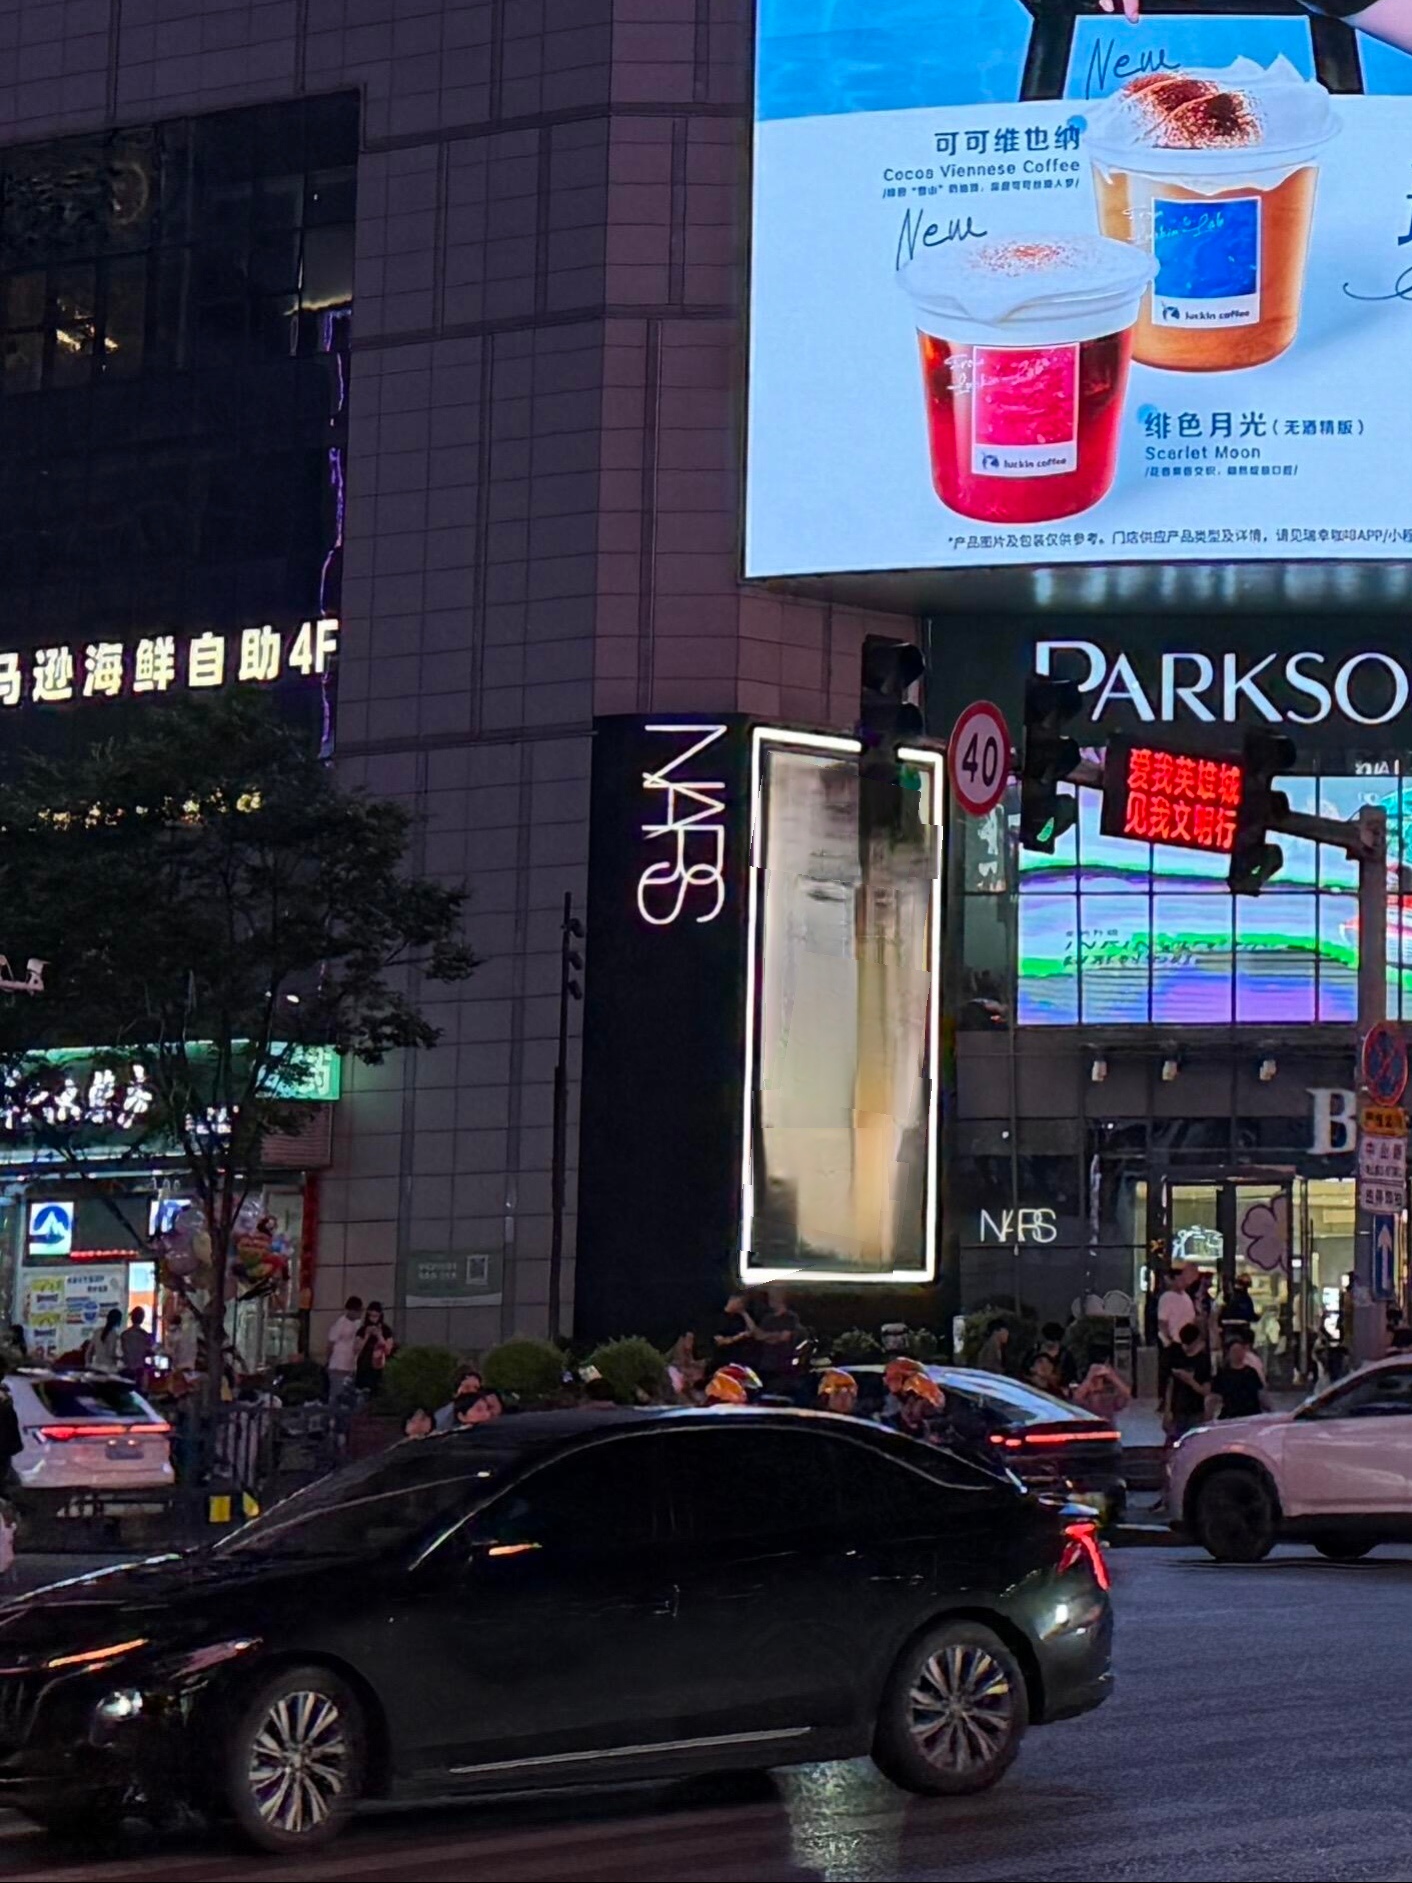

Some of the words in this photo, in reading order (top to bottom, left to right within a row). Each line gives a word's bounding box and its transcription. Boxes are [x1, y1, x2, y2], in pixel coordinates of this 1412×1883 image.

[1087, 37, 1181, 101] New
[934, 124, 1081, 156] 可可维也纳
[940, 162, 1017, 178] Viennese
[1022, 157, 1081, 174] Coffee
[895, 207, 988, 272] New
[1144, 445, 1208, 461] Scarlet
[1214, 445, 1261, 460] Moon
[962, 732, 998, 787] 40
[1126, 747, 1241, 805] 爱我英雄城
[638, 724, 727, 924] NARS
[1124, 790, 1237, 849] 见我文明行
[980, 1208, 1057, 1244] NARS
